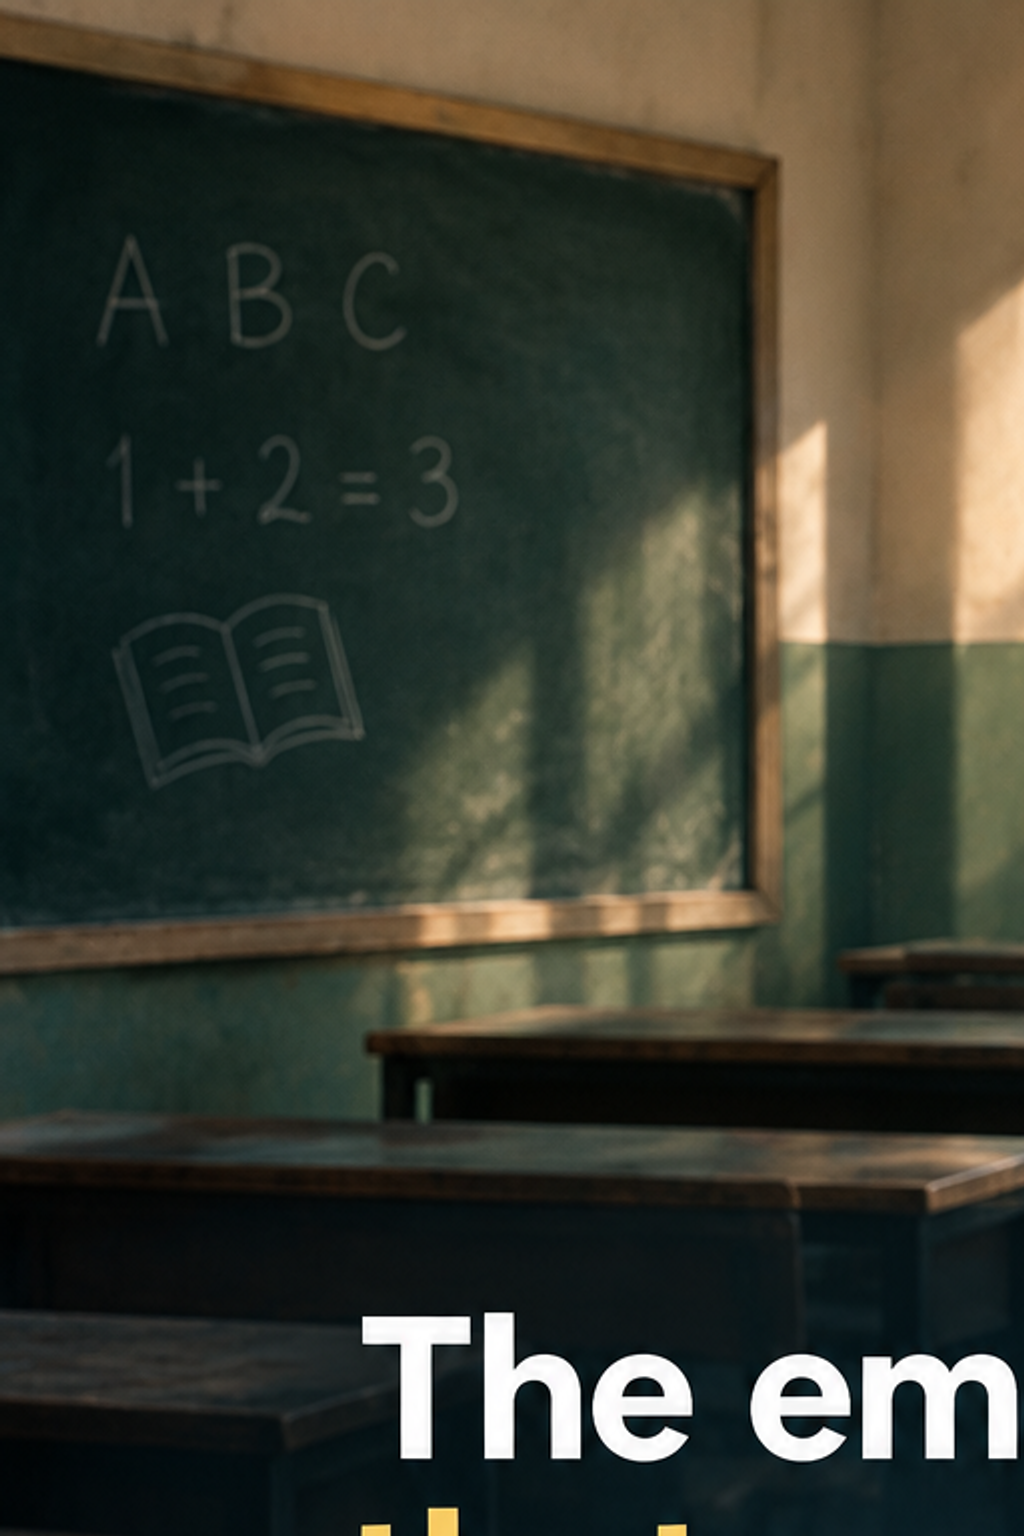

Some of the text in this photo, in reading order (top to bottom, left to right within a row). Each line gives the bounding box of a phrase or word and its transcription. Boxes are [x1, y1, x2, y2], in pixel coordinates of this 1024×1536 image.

[95, 234, 407, 352] A B C
[106, 433, 460, 529] 1 + 2 = 3
